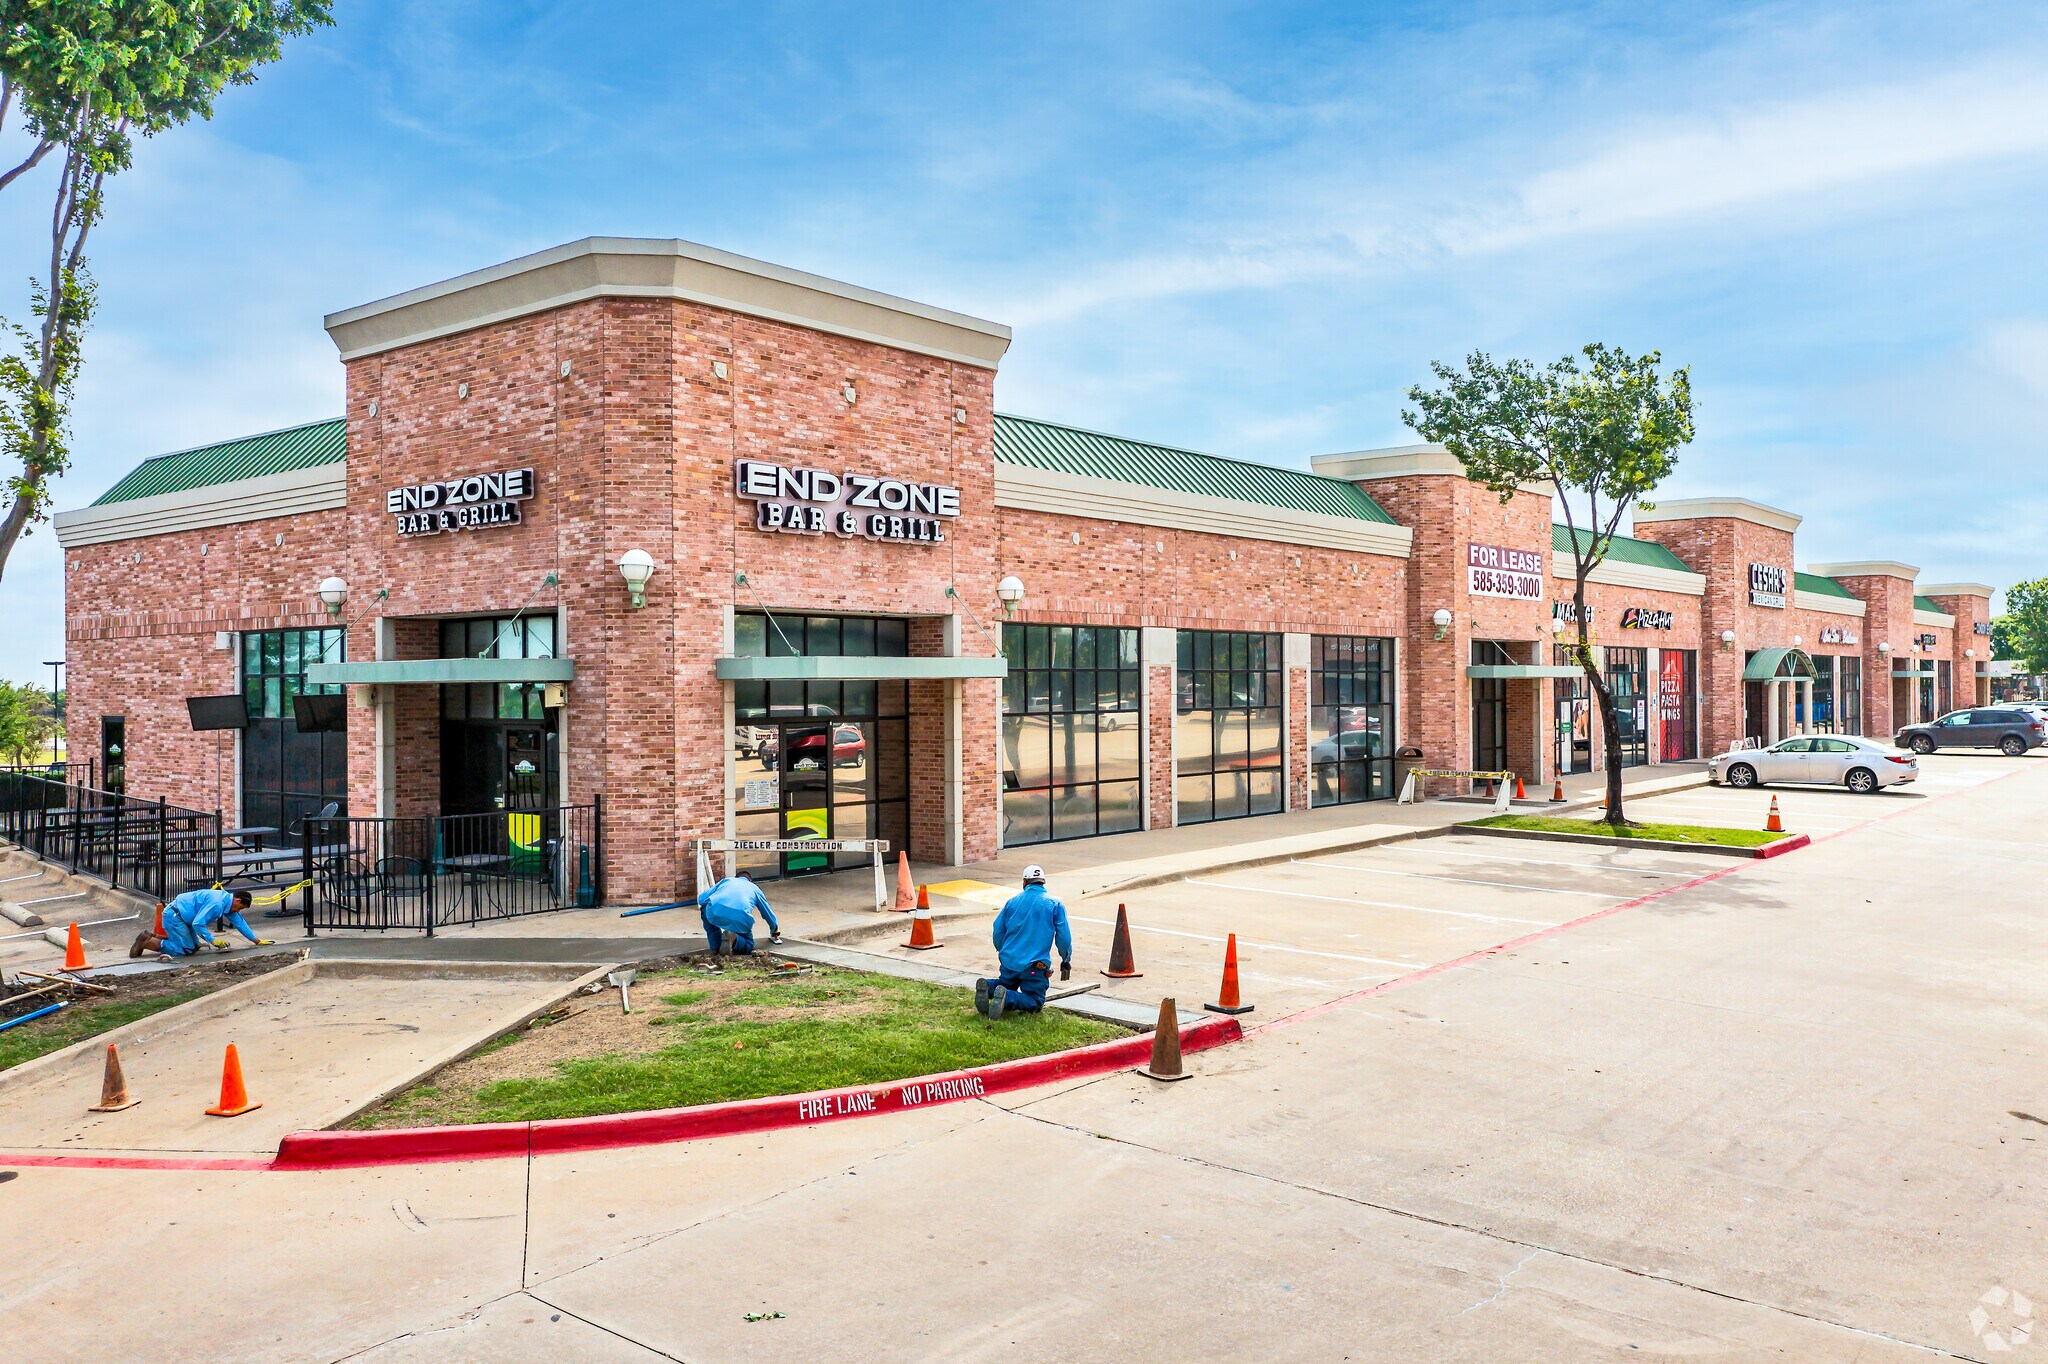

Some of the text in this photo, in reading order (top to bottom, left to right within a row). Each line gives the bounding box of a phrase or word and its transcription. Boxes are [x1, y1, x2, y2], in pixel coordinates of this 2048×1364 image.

[387, 470, 524, 513] END ZONE
[747, 462, 961, 517] END ZONE
[397, 502, 511, 534] BAR & GRILL
[767, 502, 945, 542] BAR & GRILL
[1470, 545, 1542, 573] FOR LEASE
[1473, 570, 1540, 598] 585-359-3000
[1556, 603, 1595, 623] MASGE
[1660, 680, 1680, 693] PIZZA
[1661, 694, 1680, 707] PASTA
[734, 841, 843, 851] ZIEGLER CONSTRUCTION
[1033, 869, 1041, 877] S
[800, 1076, 985, 1120] FIRE LANE NO PARKING
